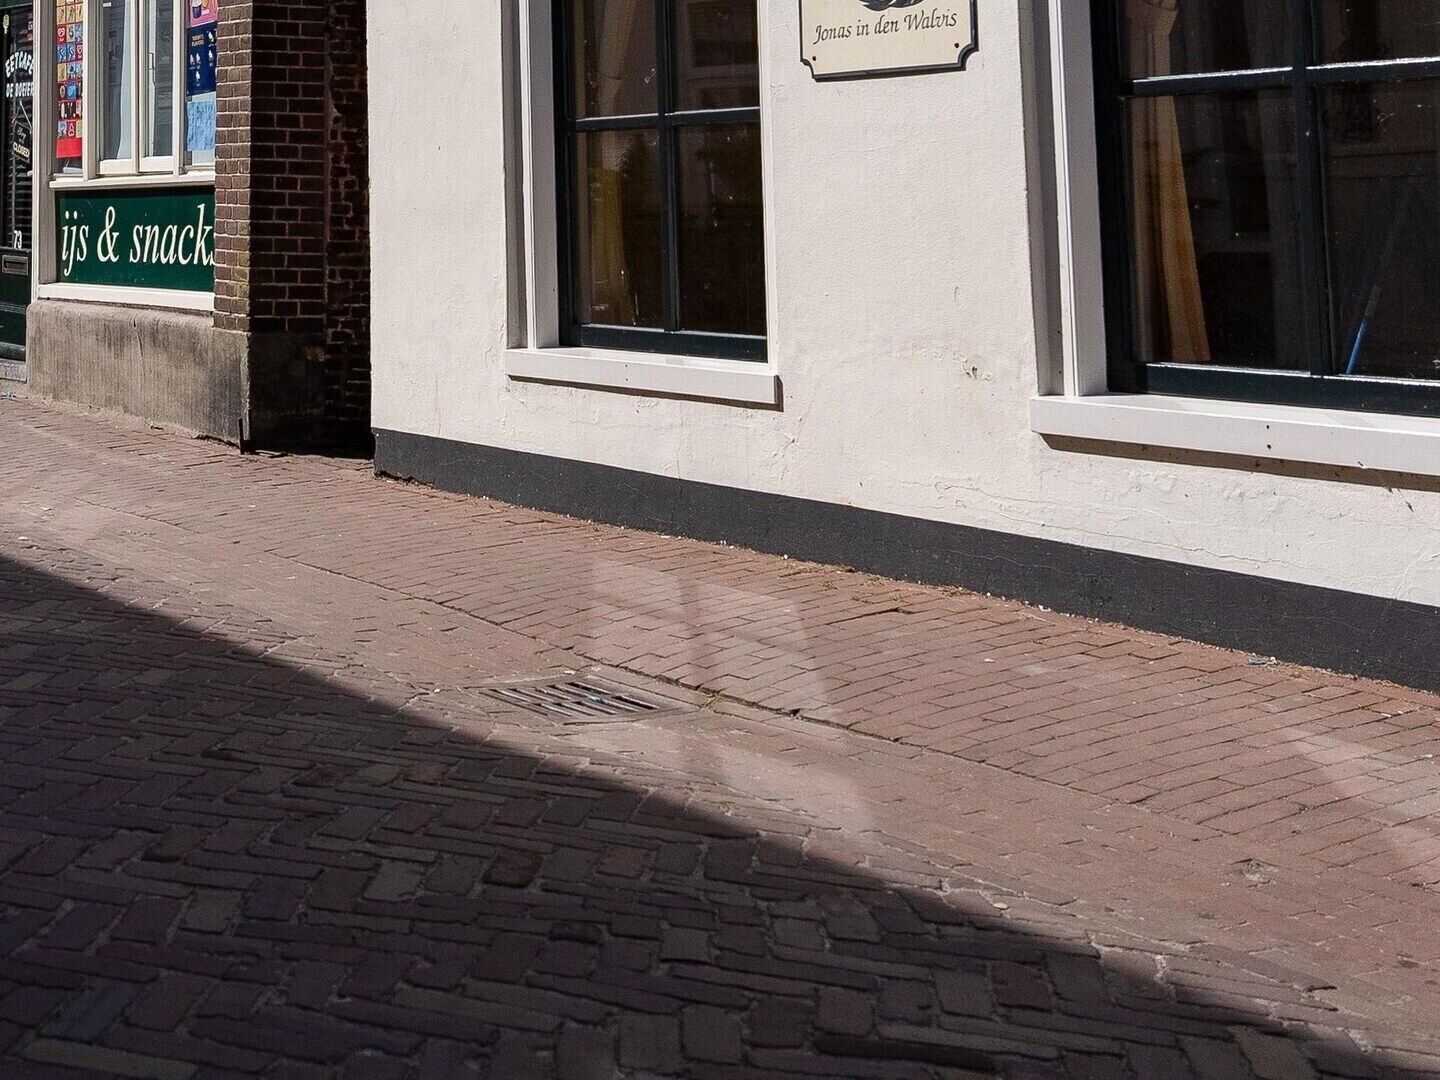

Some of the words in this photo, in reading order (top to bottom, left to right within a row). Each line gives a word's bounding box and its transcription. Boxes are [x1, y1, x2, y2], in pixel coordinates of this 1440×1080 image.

[813, 24, 852, 45] Jonas
[856, 19, 870, 36] in
[874, 14, 900, 34] den
[903, 8, 957, 31] Walvis
[13, 230, 22, 250] 73
[61, 210, 89, 277] ijs
[97, 206, 120, 263] &
